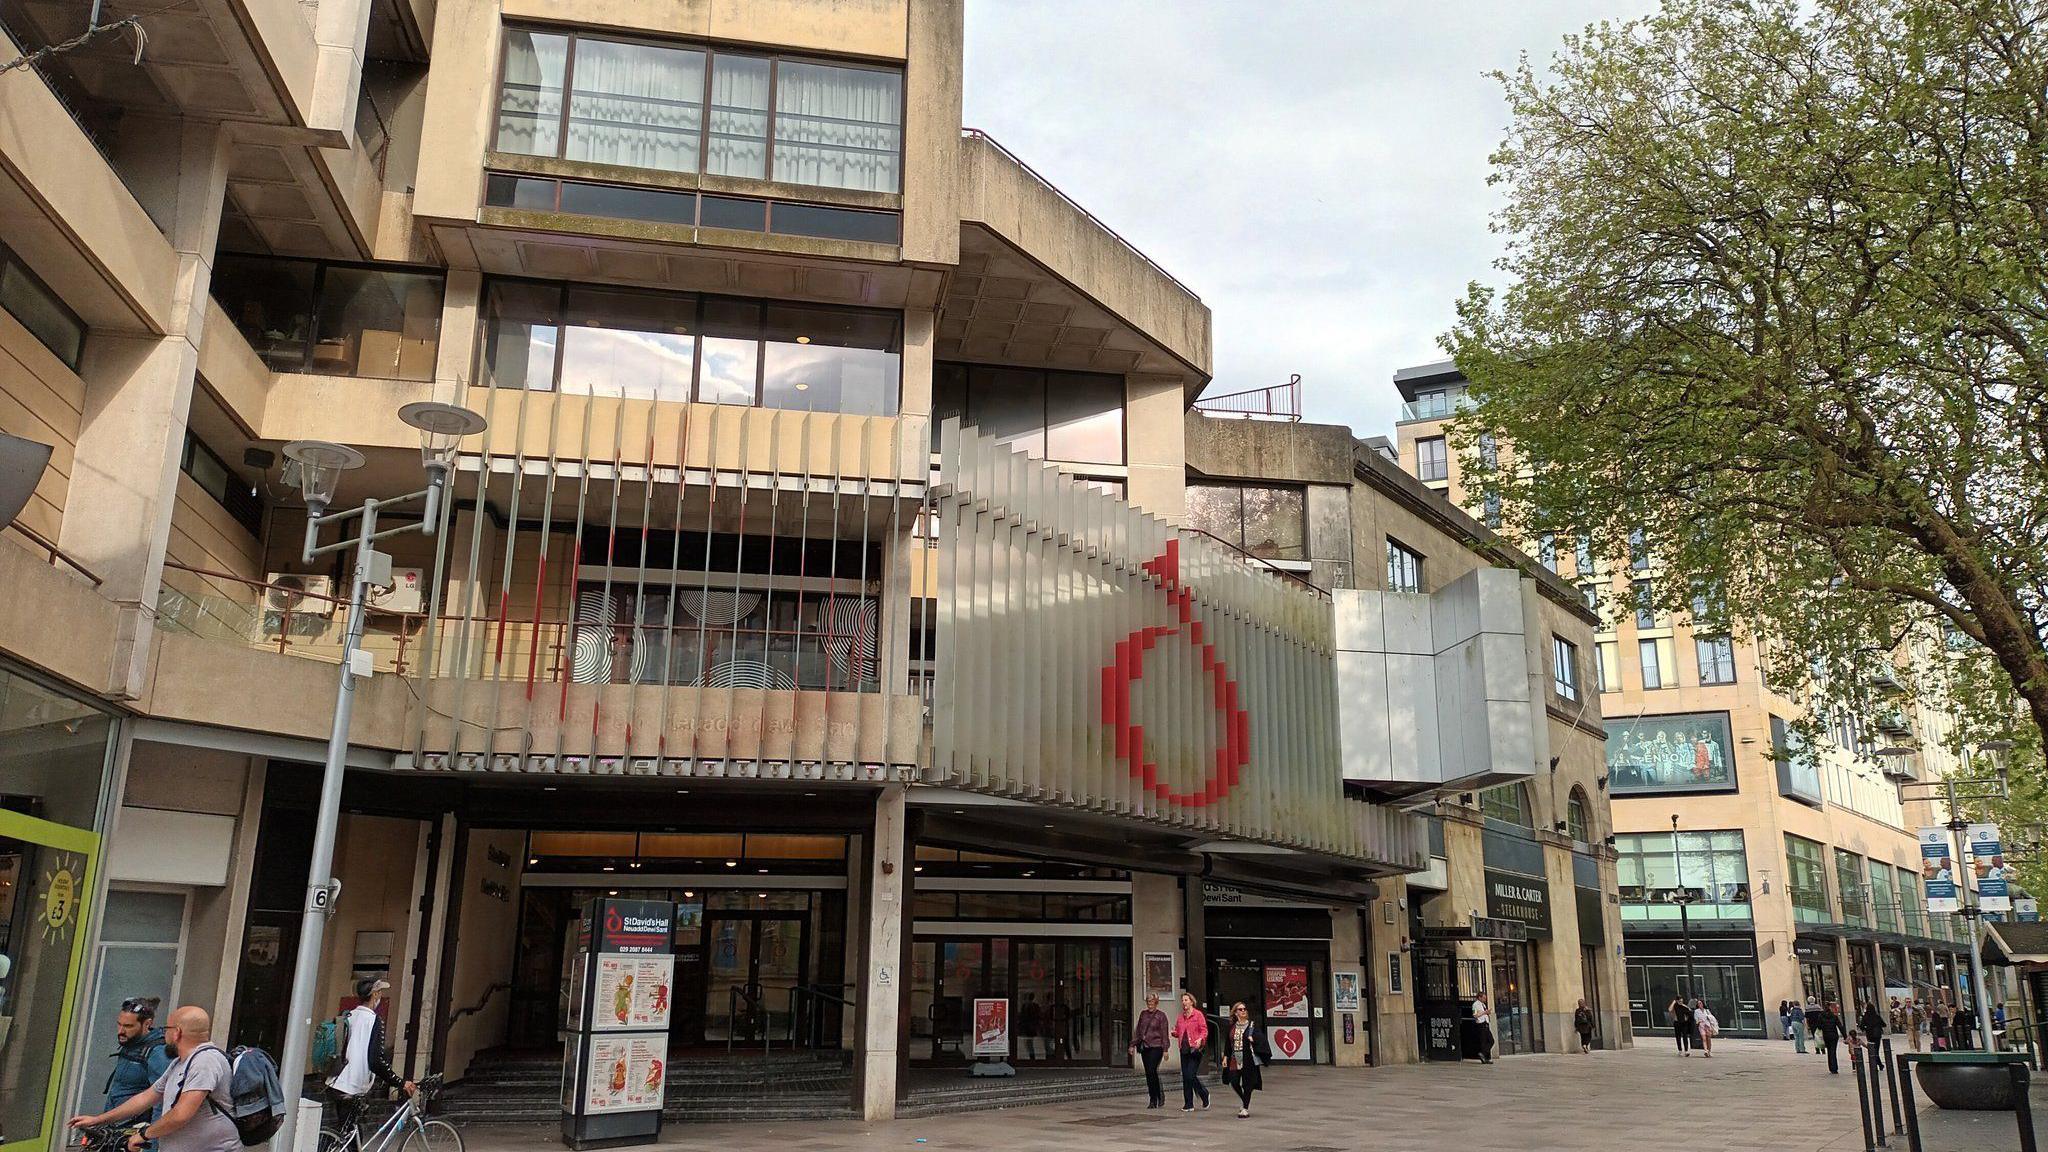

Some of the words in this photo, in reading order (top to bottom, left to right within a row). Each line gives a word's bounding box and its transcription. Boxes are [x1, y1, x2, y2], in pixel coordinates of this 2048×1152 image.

[1645, 752, 1688, 763] ENJOY
[316, 890, 327, 906] 6
[1222, 894, 1241, 902] Sant
[1495, 883, 1516, 899] MILLER
[1516, 886, 1522, 900] &
[1522, 887, 1542, 903] CARTER
[52, 901, 65, 919] £3
[1501, 903, 1539, 920] STEAKHOUSE
[632, 917, 656, 926] David's
[656, 918, 669, 927] Hall
[1430, 1017, 1453, 1028] BOWL
[1431, 1027, 1450, 1038] PLAY
[1432, 1038, 1447, 1048] FUN
